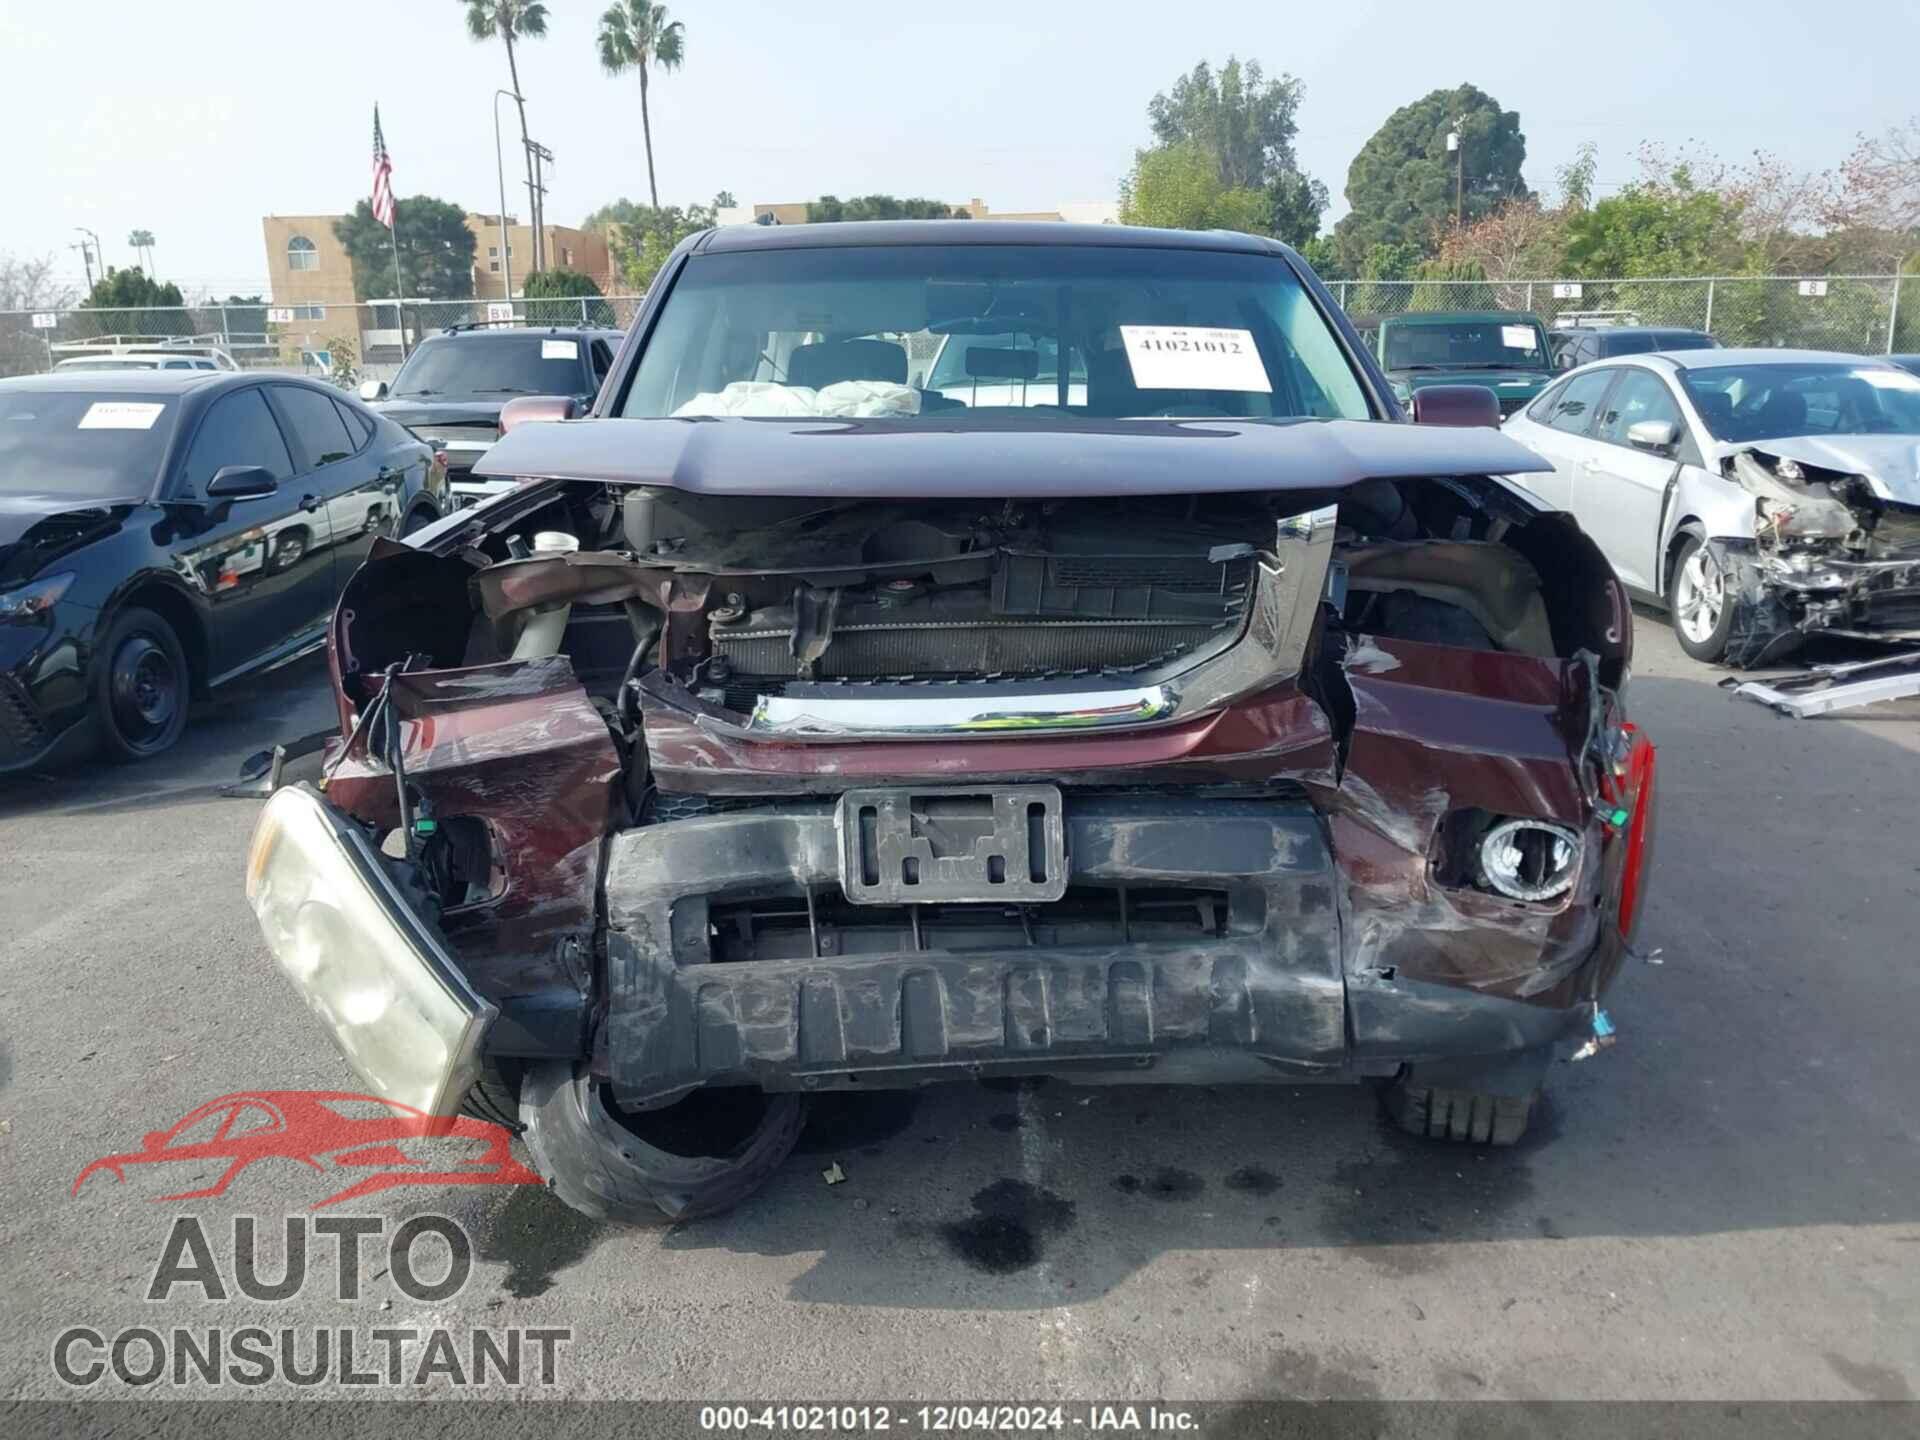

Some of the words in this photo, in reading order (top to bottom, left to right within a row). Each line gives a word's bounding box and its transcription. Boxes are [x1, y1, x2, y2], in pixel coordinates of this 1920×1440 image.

[1563, 284, 1572, 297] 9
[1809, 281, 1817, 295] 8
[1139, 339, 1244, 354] 41021012
